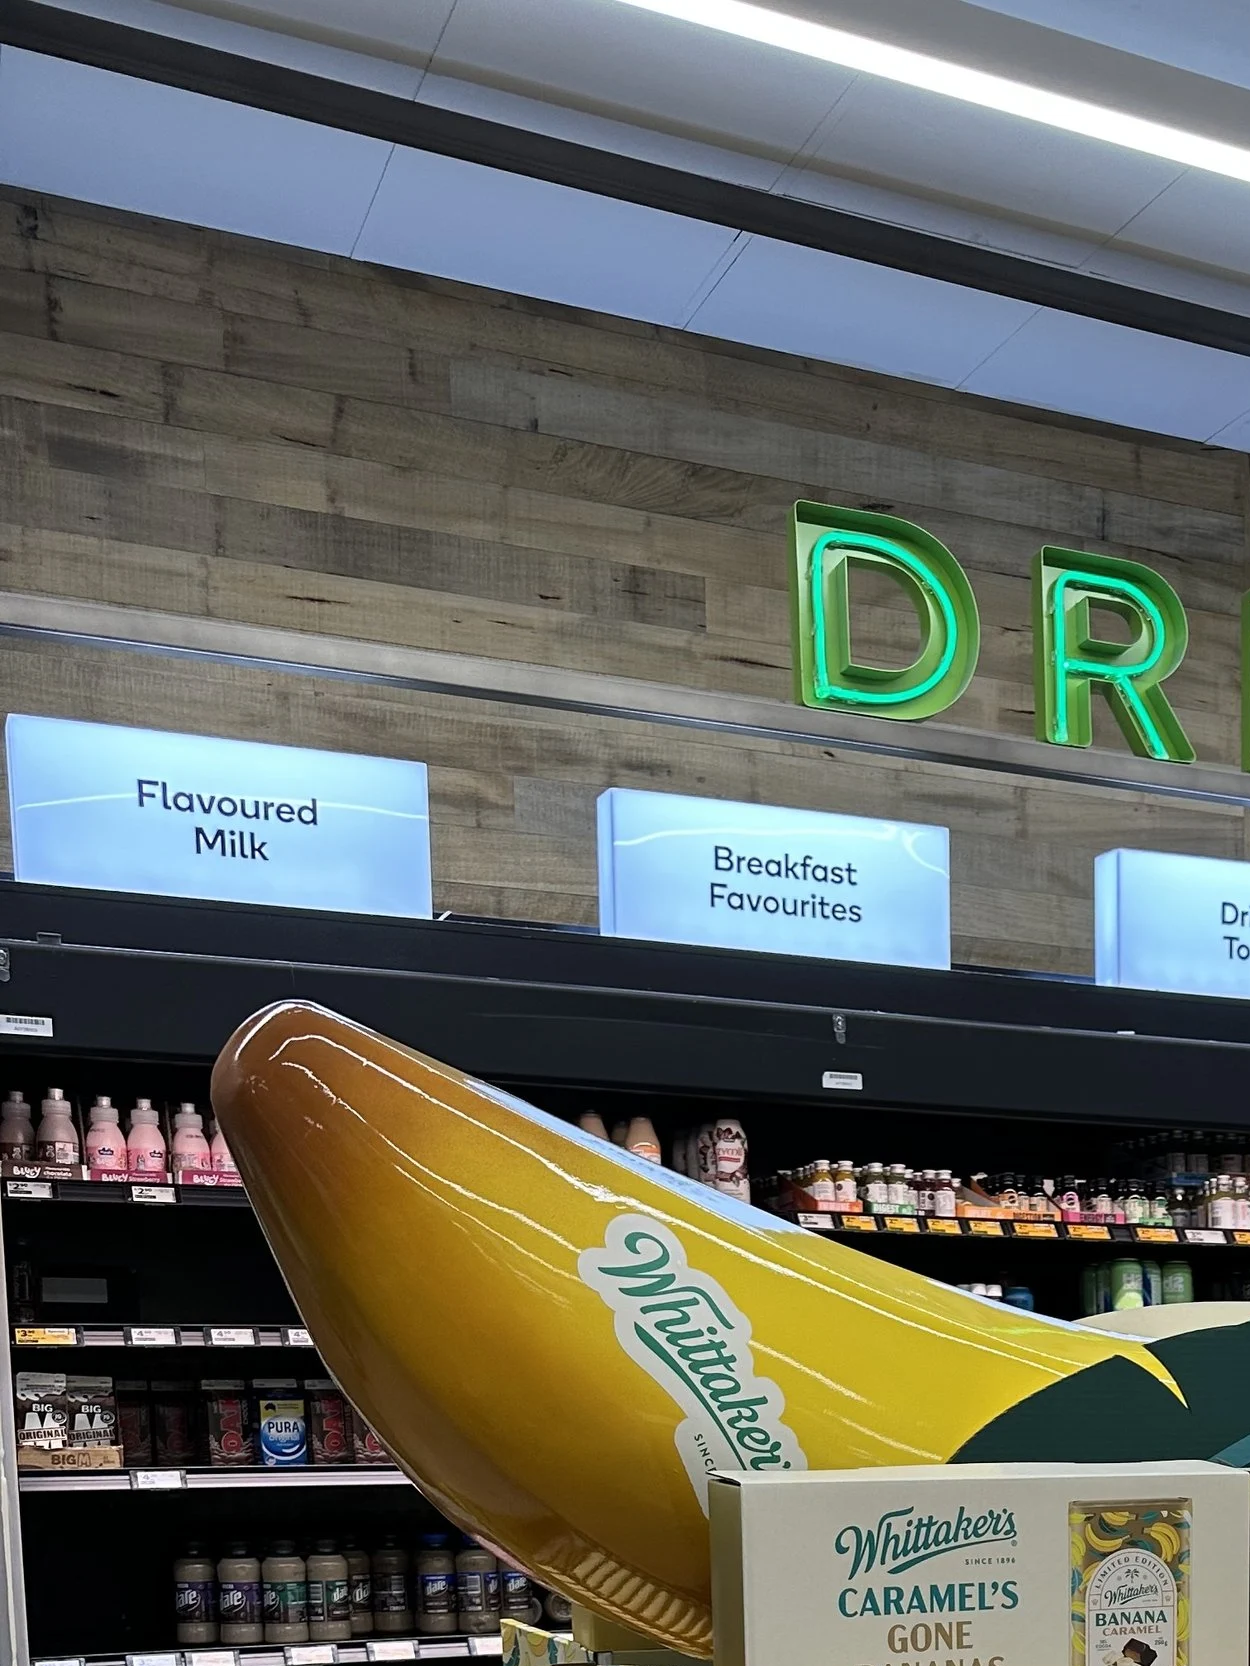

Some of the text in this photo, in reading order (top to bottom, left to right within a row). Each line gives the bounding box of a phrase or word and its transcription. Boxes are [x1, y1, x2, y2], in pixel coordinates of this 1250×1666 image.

[136, 778, 319, 827] Flavoured
[195, 826, 269, 862] Milk
[713, 845, 858, 887] Breakfast
[709, 882, 863, 924] Favourites
[1223, 936, 1250, 961] To
[598, 1231, 791, 1471] Whittaker'
[32, 1403, 53, 1413] BIG
[81, 1404, 101, 1414] BIG
[19, 1429, 67, 1441] ORIGINAL
[69, 1429, 114, 1440] ORIGINAL
[268, 1421, 300, 1433] PURA
[268, 1433, 299, 1442] Original
[51, 1454, 76, 1466] BIG
[835, 1506, 1018, 1581] Whittaker's
[964, 1556, 1016, 1566] SINCE 1896
[1095, 1556, 1168, 1589] LIMITED EDITION
[838, 1580, 1019, 1618] CARAMEL'S
[1104, 1584, 1158, 1607] Whittaker's
[1095, 1610, 1167, 1626] BANANA
[887, 1621, 974, 1654] GONE
[1103, 1626, 1162, 1636] CARAMEL
